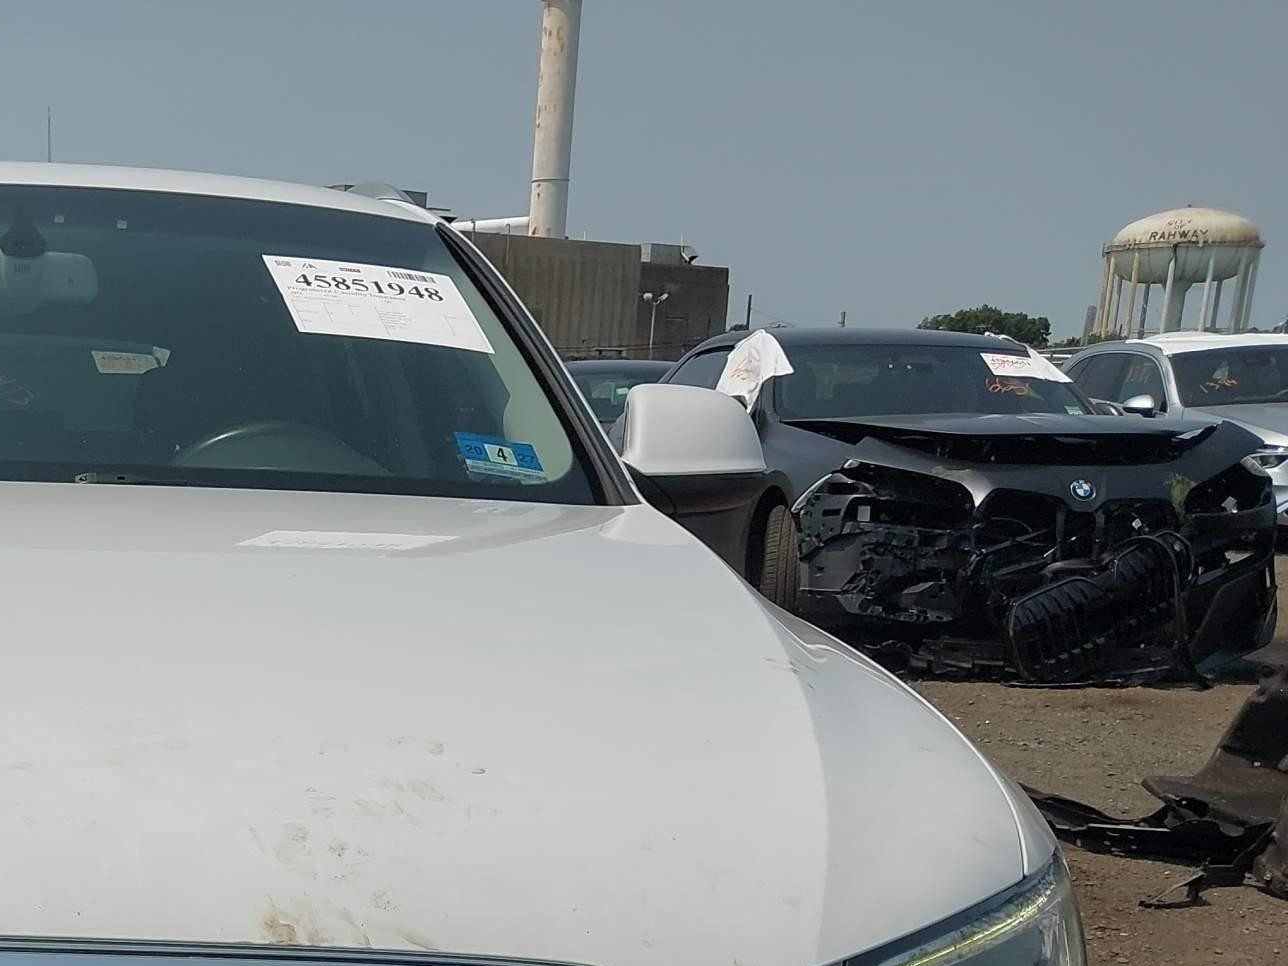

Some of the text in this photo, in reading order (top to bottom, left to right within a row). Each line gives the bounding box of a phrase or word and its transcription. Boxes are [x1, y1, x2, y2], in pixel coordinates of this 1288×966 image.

[1148, 229, 1209, 241] RAHWAY
[295, 273, 444, 302] 45851948
[464, 444, 483, 455] 20
[496, 447, 508, 462] 4
